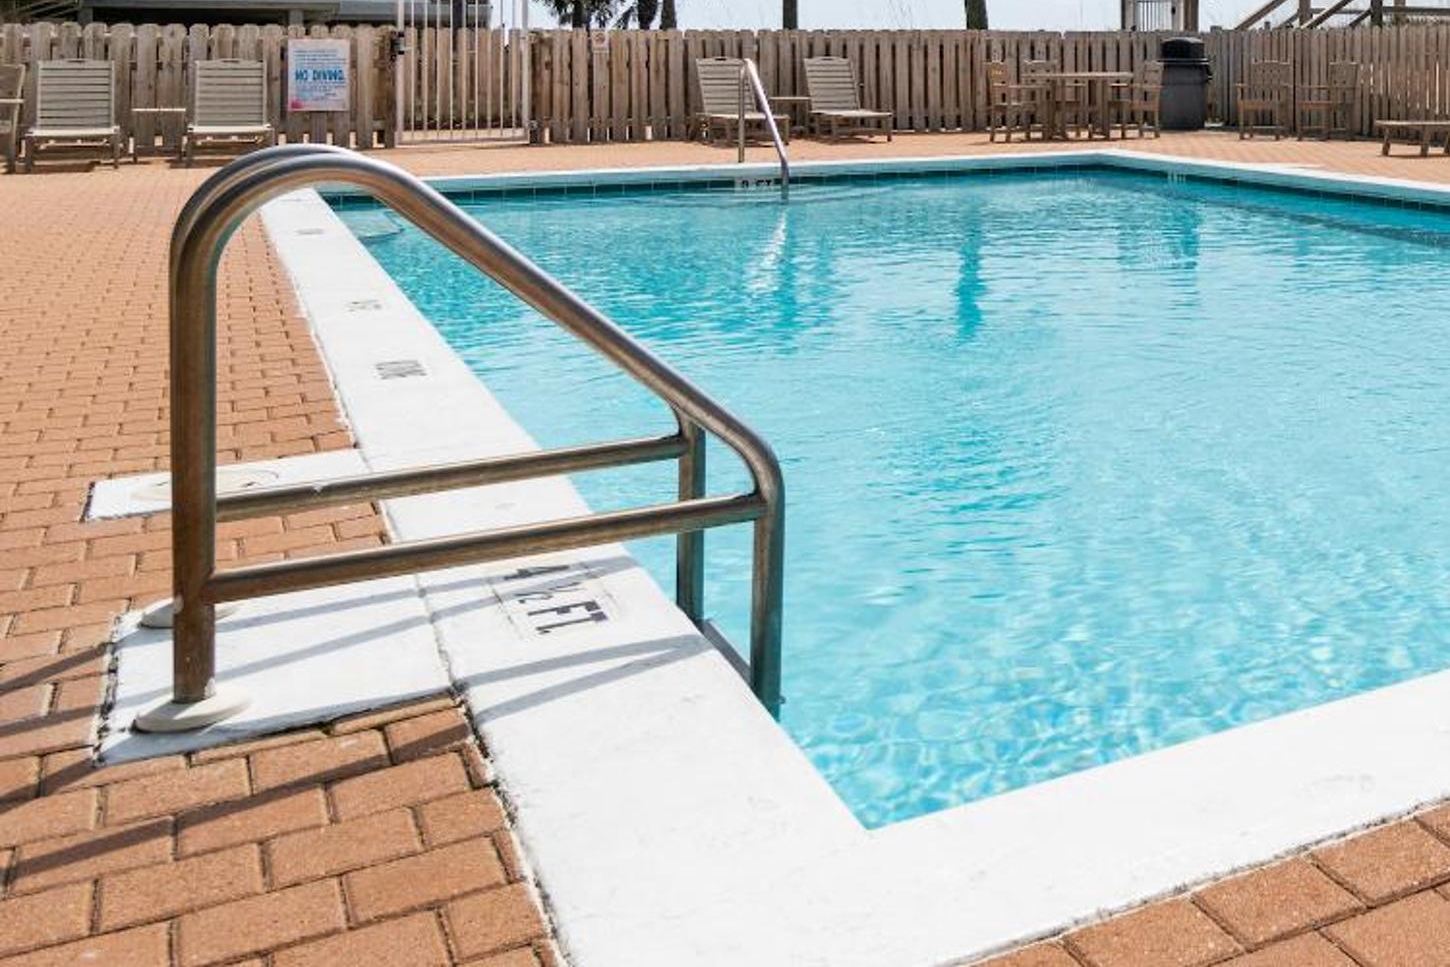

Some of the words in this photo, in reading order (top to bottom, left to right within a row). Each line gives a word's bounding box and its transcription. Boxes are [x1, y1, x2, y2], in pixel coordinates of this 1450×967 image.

[295, 69, 308, 81] NO
[313, 69, 345, 81] DIVING
[527, 599, 610, 636] FT
